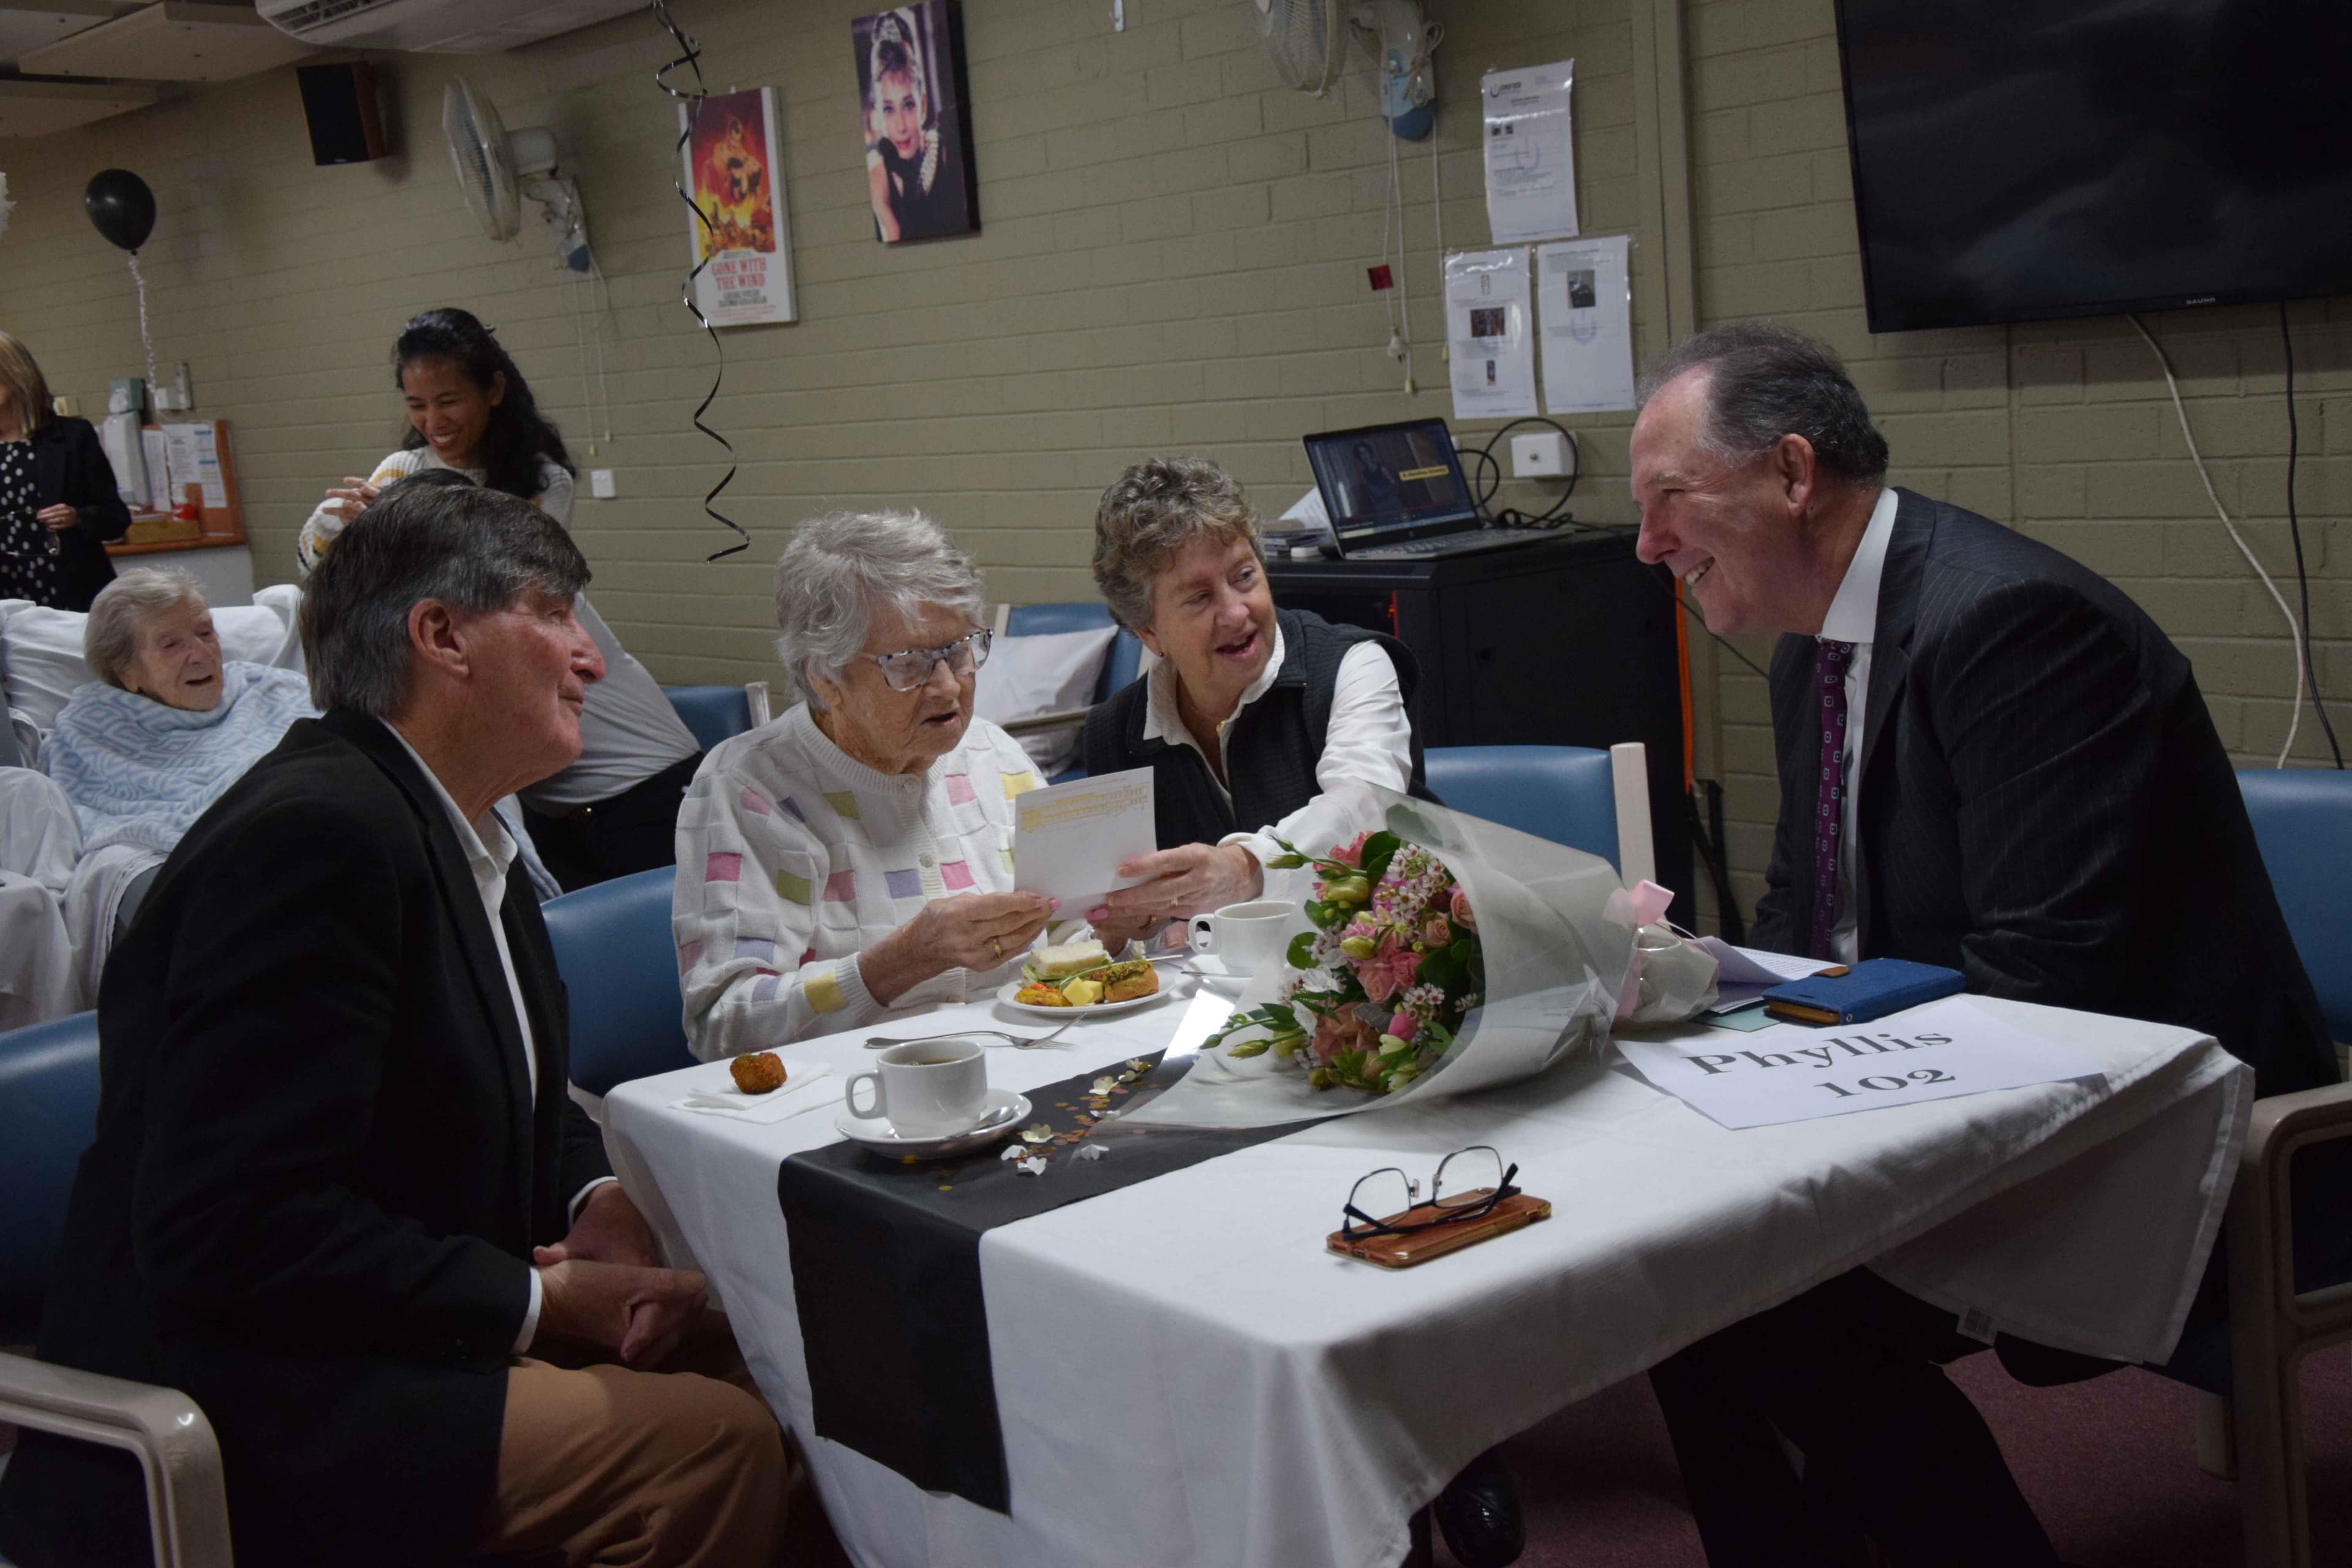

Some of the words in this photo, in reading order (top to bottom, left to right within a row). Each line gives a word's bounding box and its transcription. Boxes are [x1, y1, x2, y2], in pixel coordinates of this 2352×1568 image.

[712, 260, 737, 275] GONE
[739, 257, 767, 271] WITH
[715, 275, 736, 290] THE
[739, 273, 765, 287] WIND
[1679, 1031, 1953, 1076] Phyllis
[1814, 1068, 1956, 1098] 102
